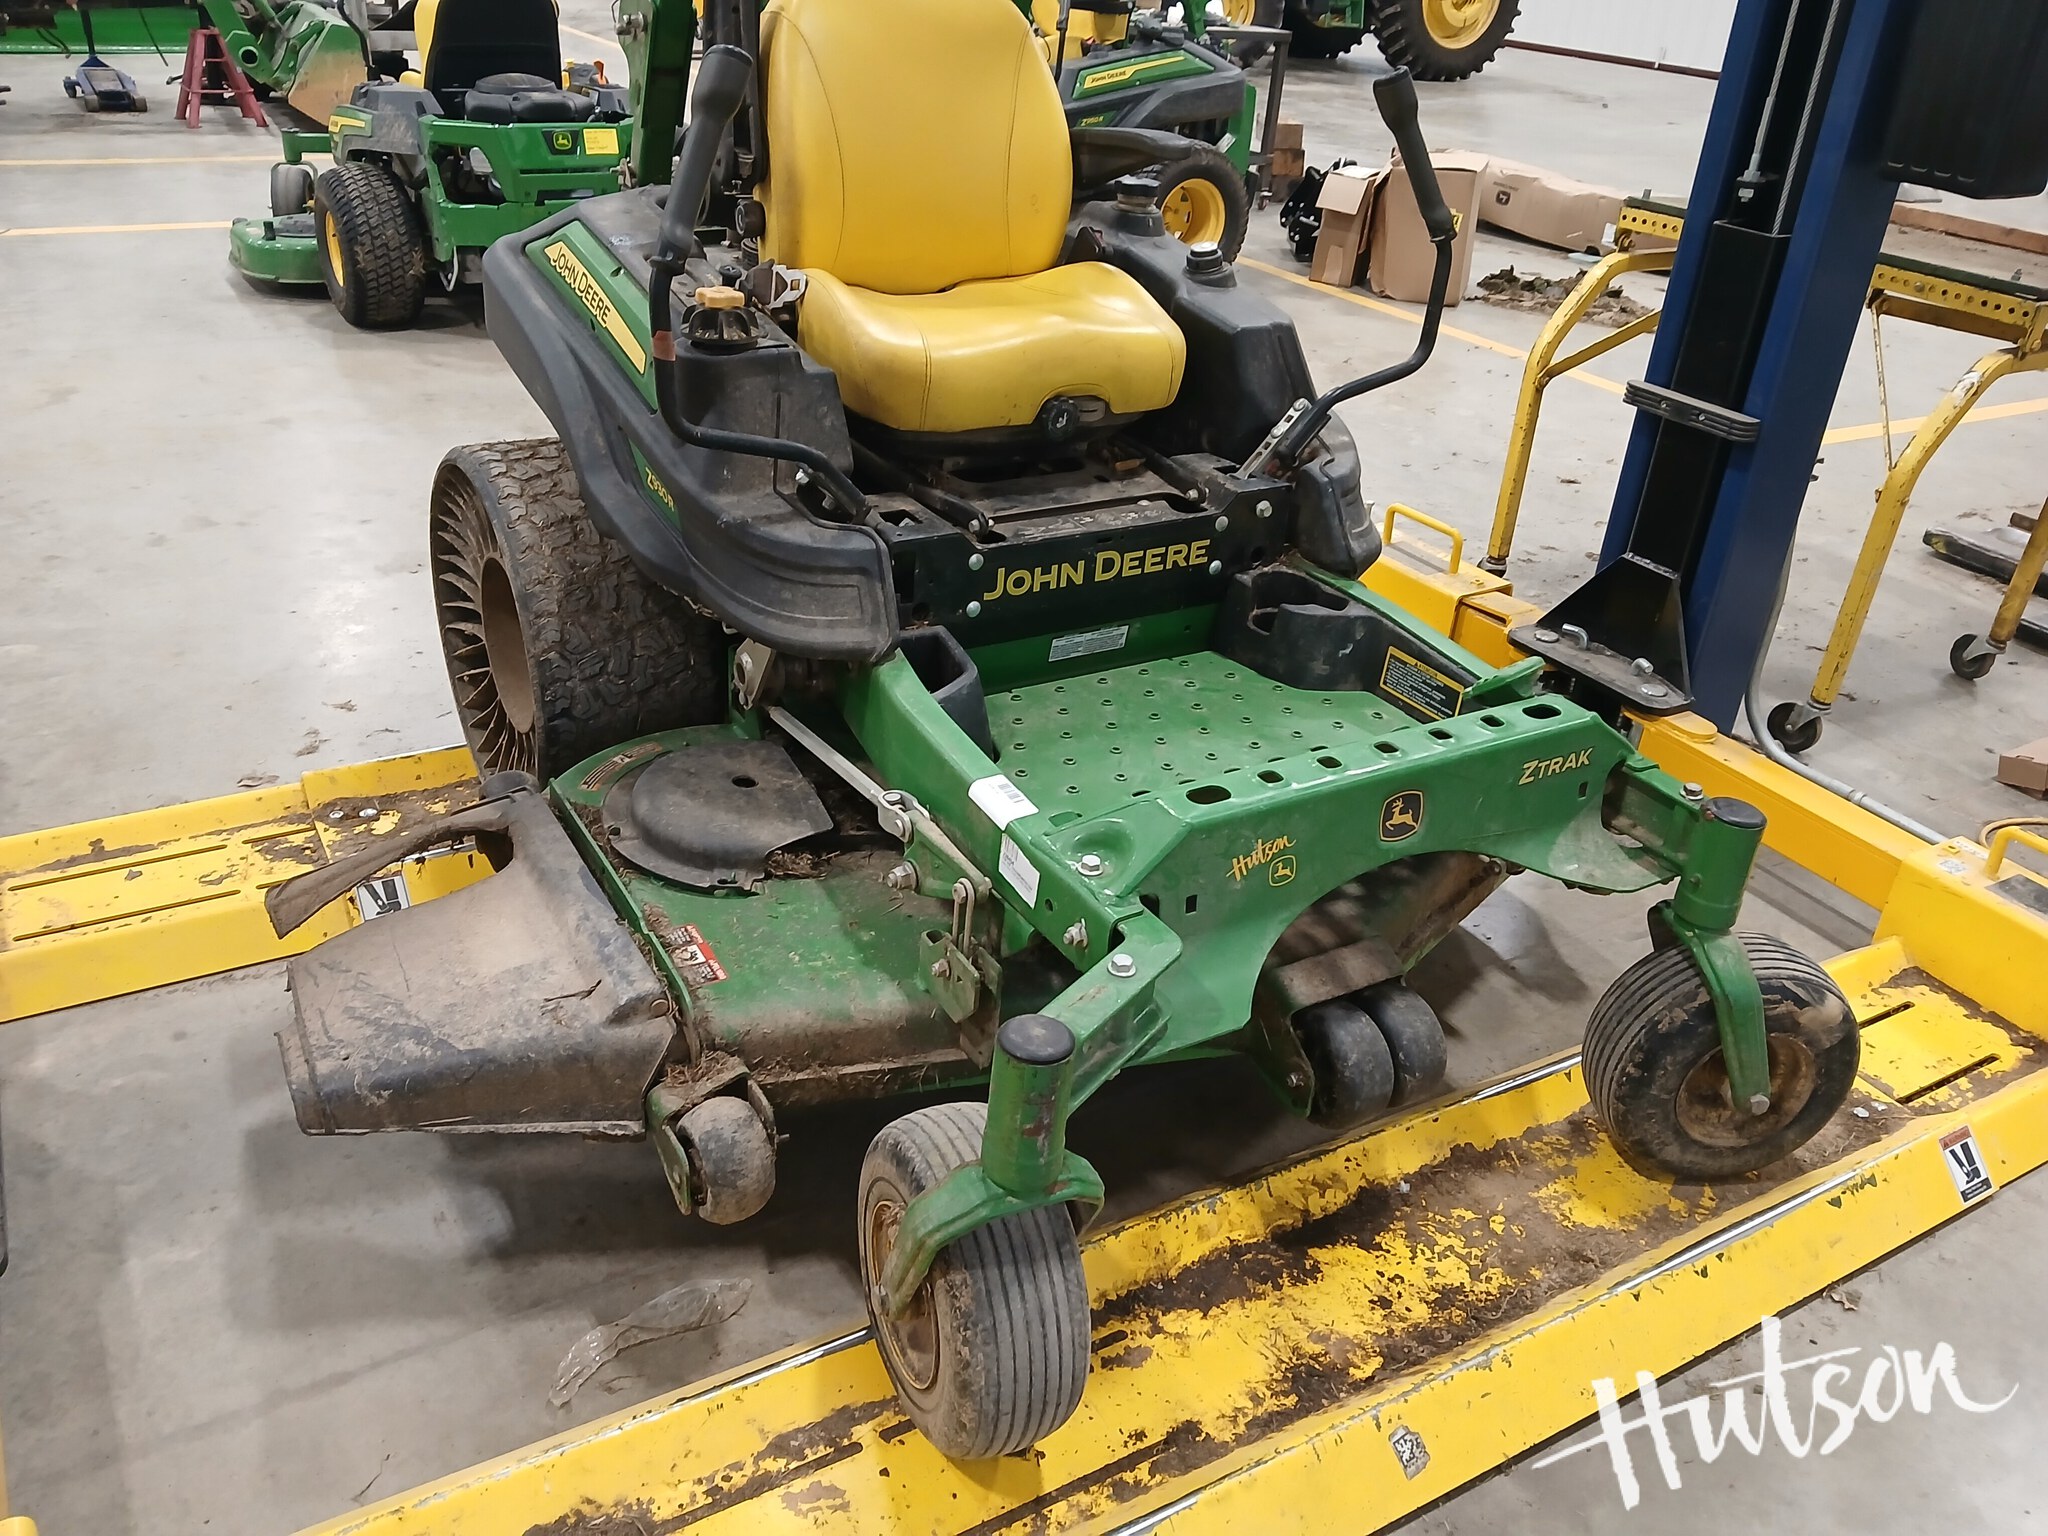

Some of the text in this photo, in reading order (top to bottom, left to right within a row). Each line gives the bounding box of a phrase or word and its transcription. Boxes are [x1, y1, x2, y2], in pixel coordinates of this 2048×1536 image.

[552, 246, 611, 325] JOHN DEERE
[983, 539, 1211, 601] JOHN DEERE
[1518, 747, 1593, 786] ZTRAK
[1225, 835, 1297, 882] Hutson
